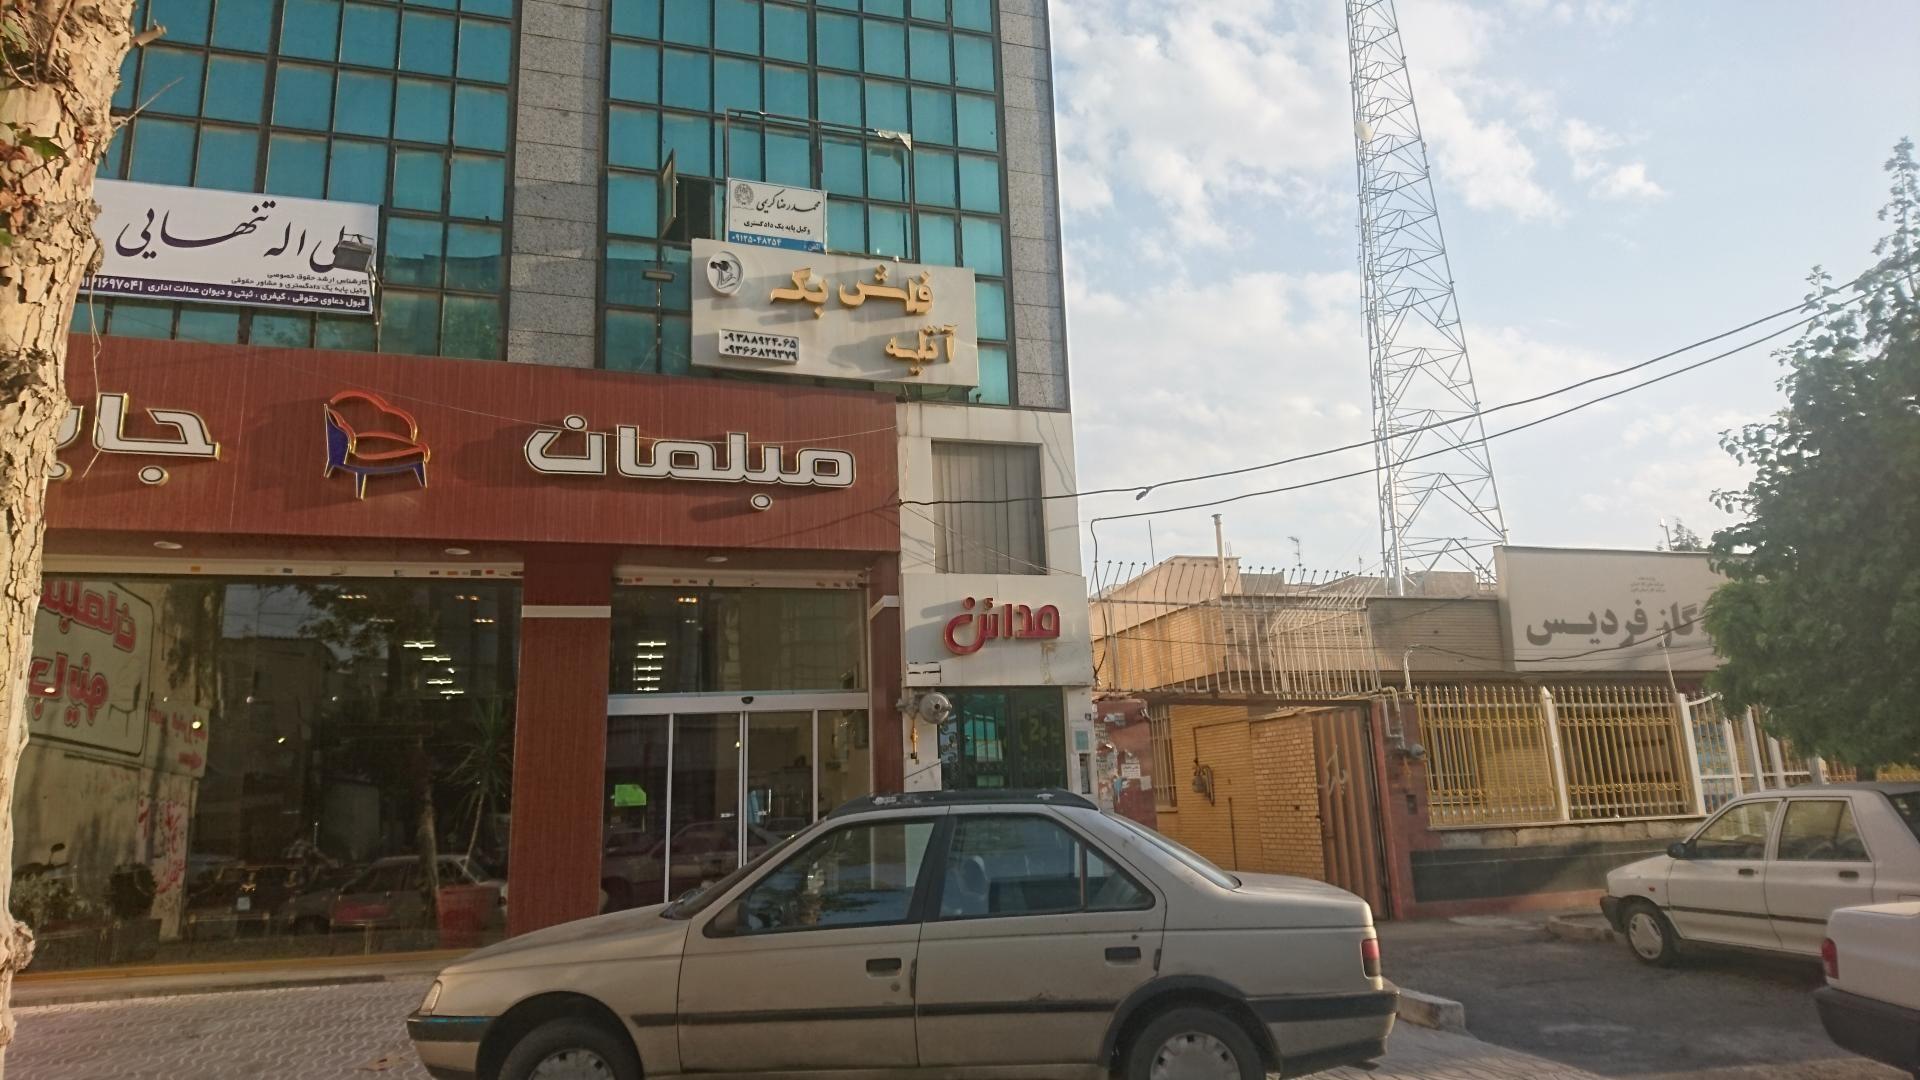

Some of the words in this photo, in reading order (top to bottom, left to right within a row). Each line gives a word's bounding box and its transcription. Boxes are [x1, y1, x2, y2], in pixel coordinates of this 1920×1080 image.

[115, 200, 276, 259] تنهایی
[267, 271, 295, 279] خصوصی
[297, 274, 315, 282] حقوق
[231, 276, 254, 285] حقوقی
[256, 280, 277, 288] مشاور
[317, 276, 335, 284] ارشد
[147, 284, 172, 293] اداری
[174, 285, 199, 293] عدالت
[285, 281, 320, 289] دادگستری
[322, 284, 333, 292] یک
[201, 287, 225, 296] دیوان
[234, 289, 254, 299] ثبتی
[335, 286, 349, 294] پایه
[349, 287, 366, 295] وکیل
[260, 291, 286, 301] کیفری
[292, 293, 319, 304] حقوقی
[320, 296, 344, 306] دعاوی
[345, 298, 366, 307] قبول
[886, 324, 958, 377] آتلیه
[523, 413, 857, 511] مبلمان
[943, 597, 1060, 655] مدائن
[1526, 600, 1649, 647] فردیس
[1656, 601, 1698, 648] گاز
